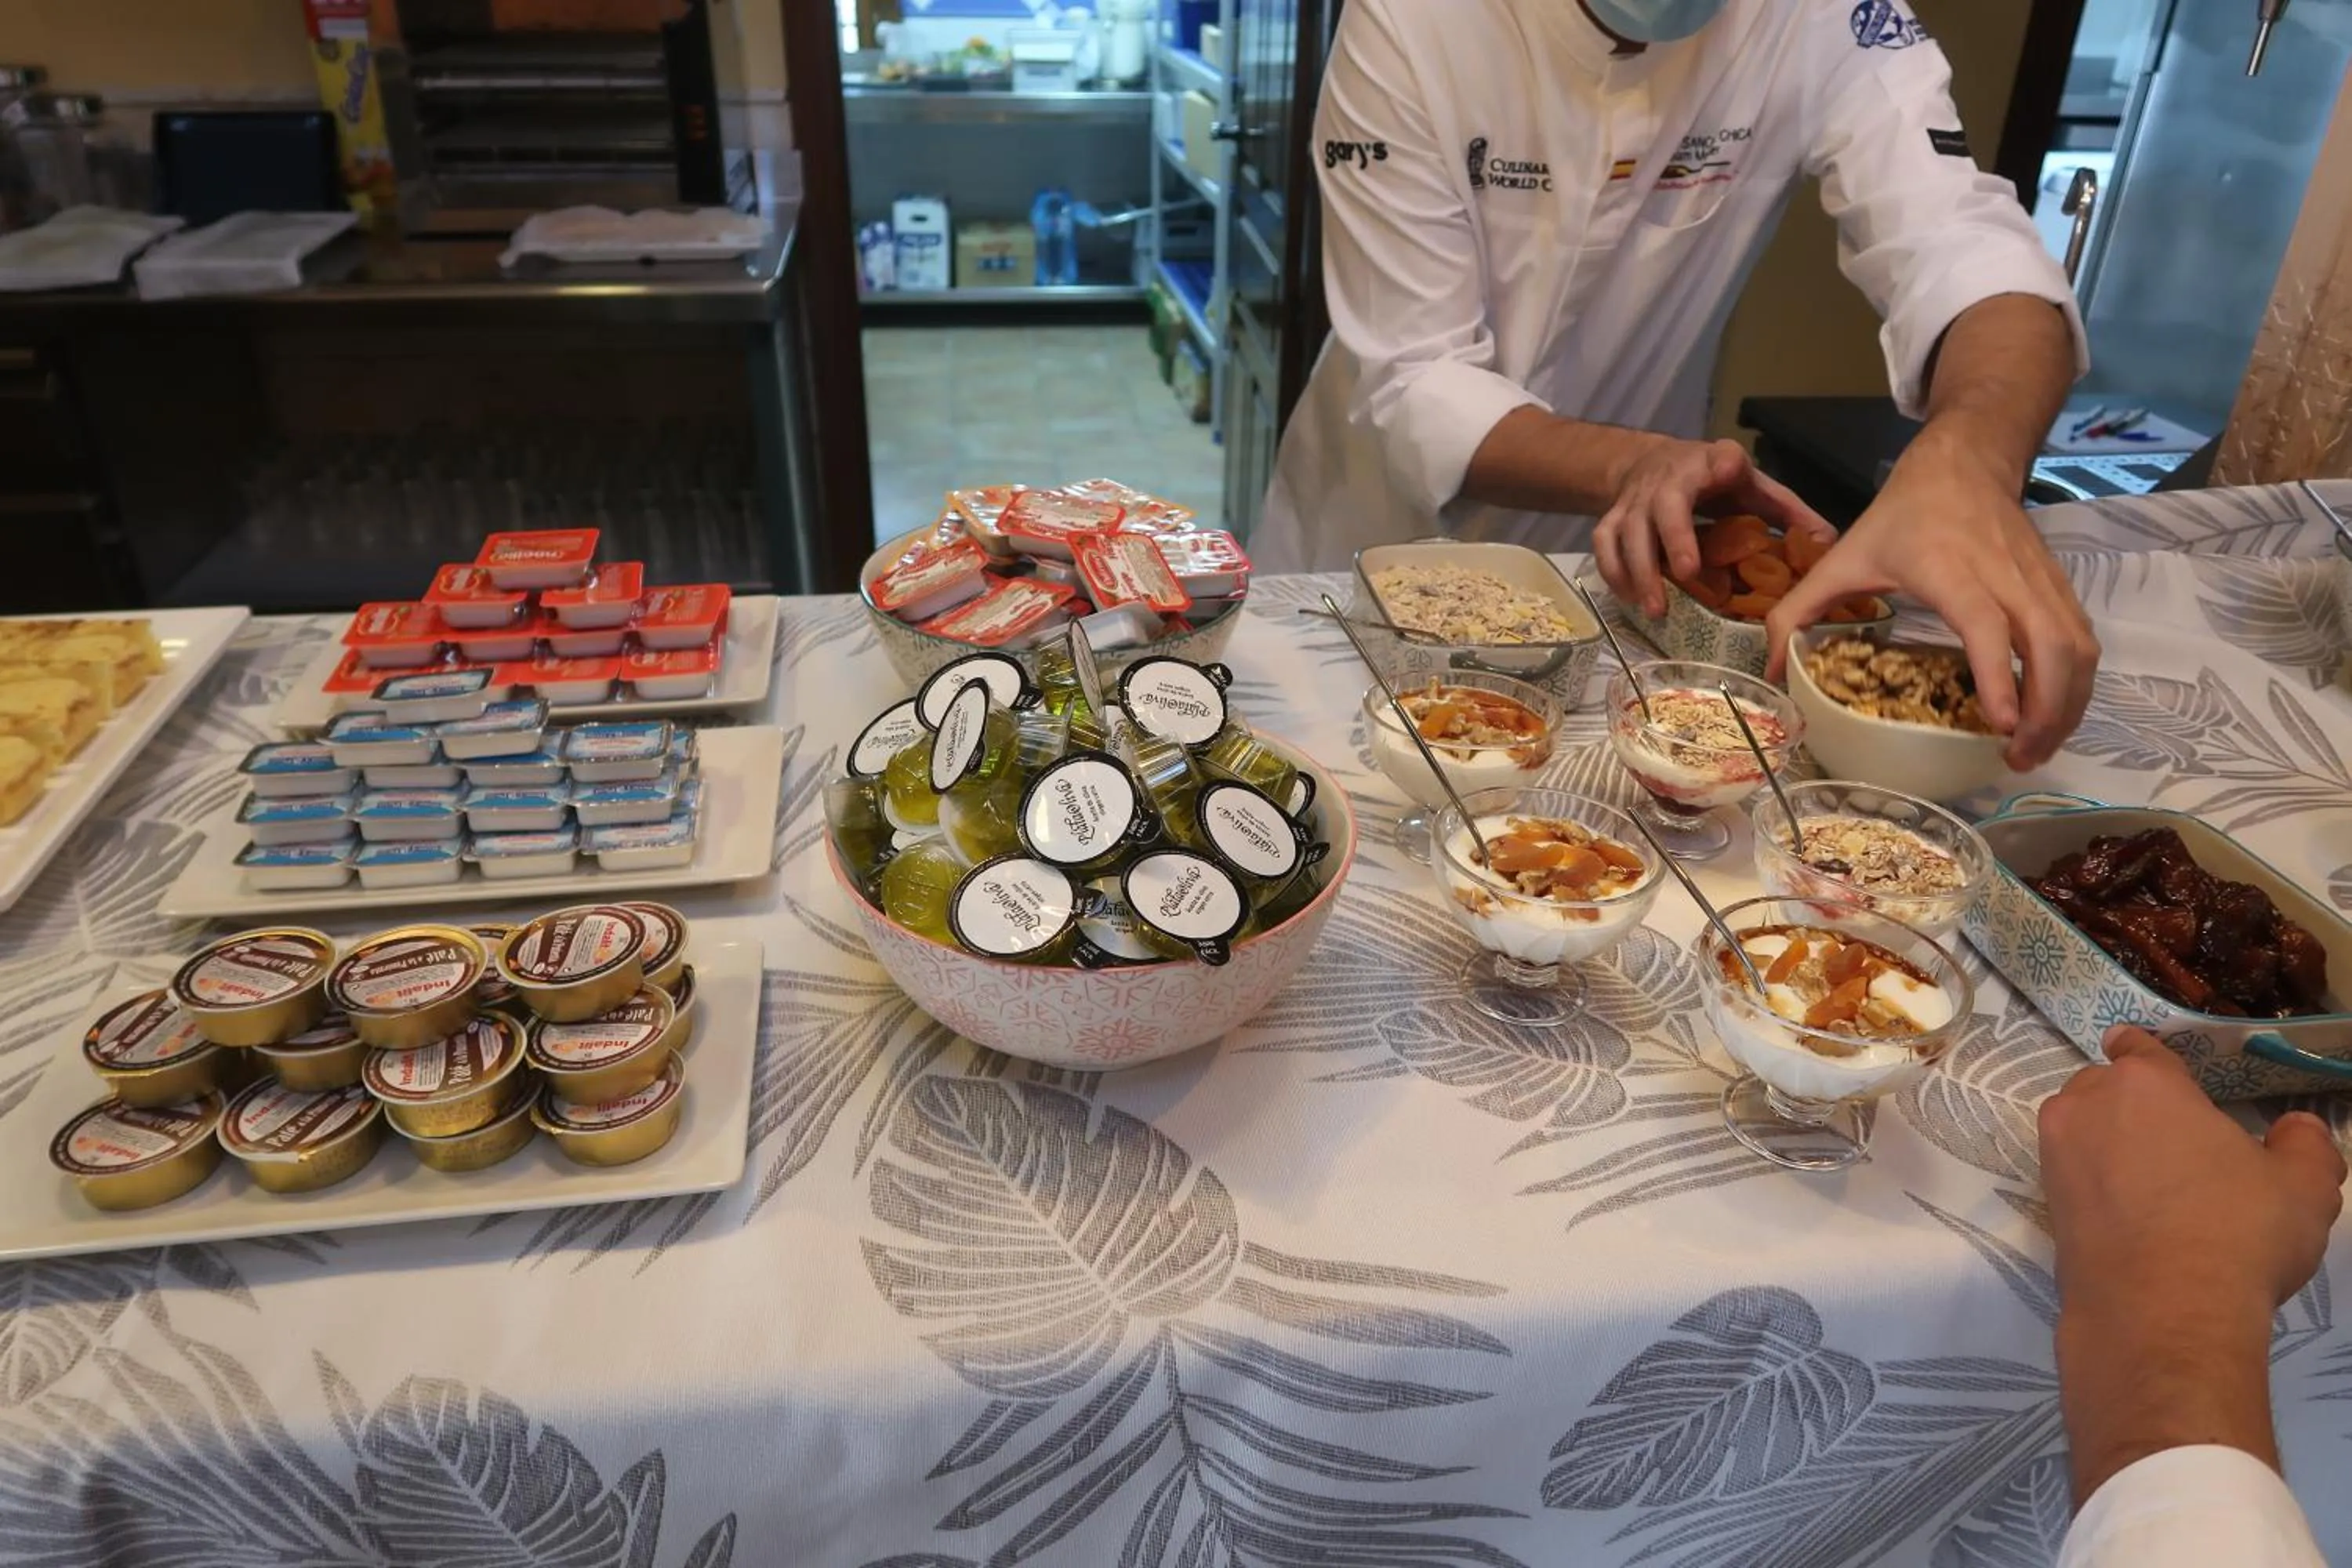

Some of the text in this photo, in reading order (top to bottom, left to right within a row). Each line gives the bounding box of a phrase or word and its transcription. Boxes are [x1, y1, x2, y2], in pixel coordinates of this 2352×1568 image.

[1325, 140, 1388, 170] gary's
[1490, 158, 1550, 175] CULINAR
[1488, 172, 1554, 193] WORLD C
[426, 948, 457, 964] Paté
